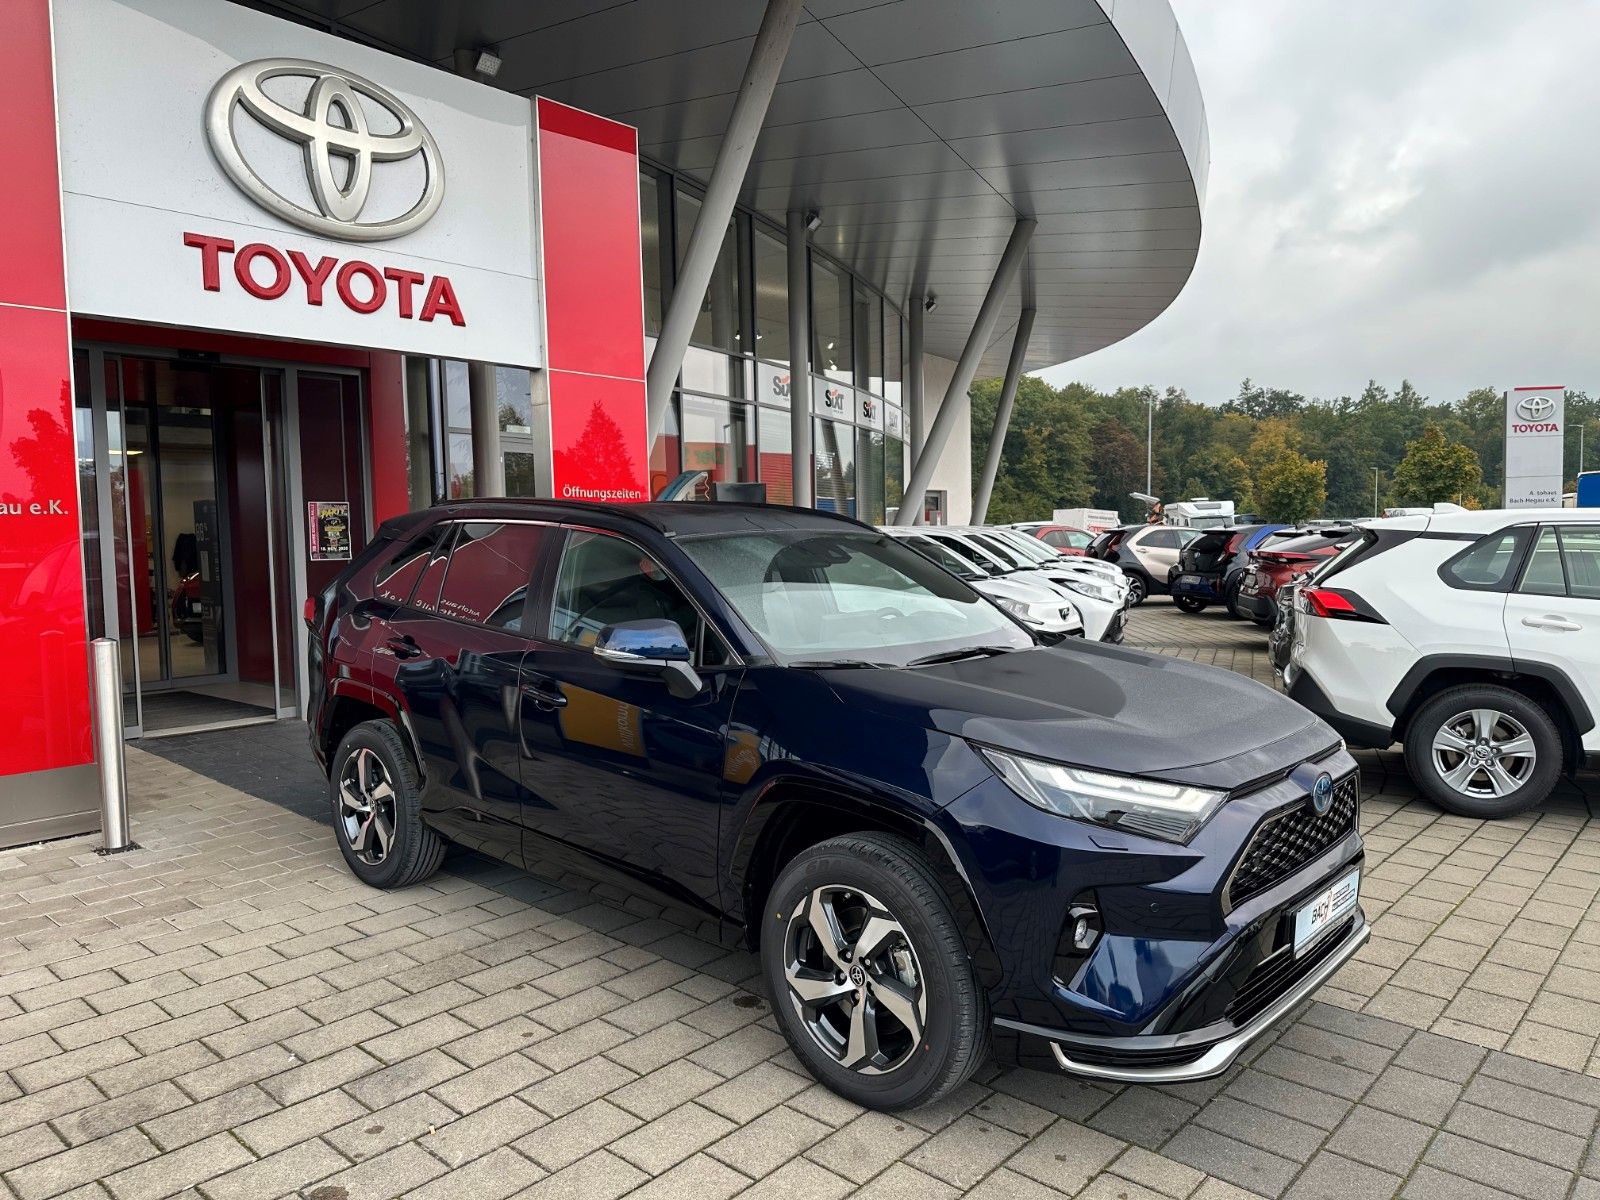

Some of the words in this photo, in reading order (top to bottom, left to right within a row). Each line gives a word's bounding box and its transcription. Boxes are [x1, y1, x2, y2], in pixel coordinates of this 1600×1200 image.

[184, 232, 466, 328] TOYOTA
[1512, 424, 1559, 433] TOYOTA
[563, 484, 641, 501] Öffnungszeiten
[29, 499, 69, 515] e.K.
